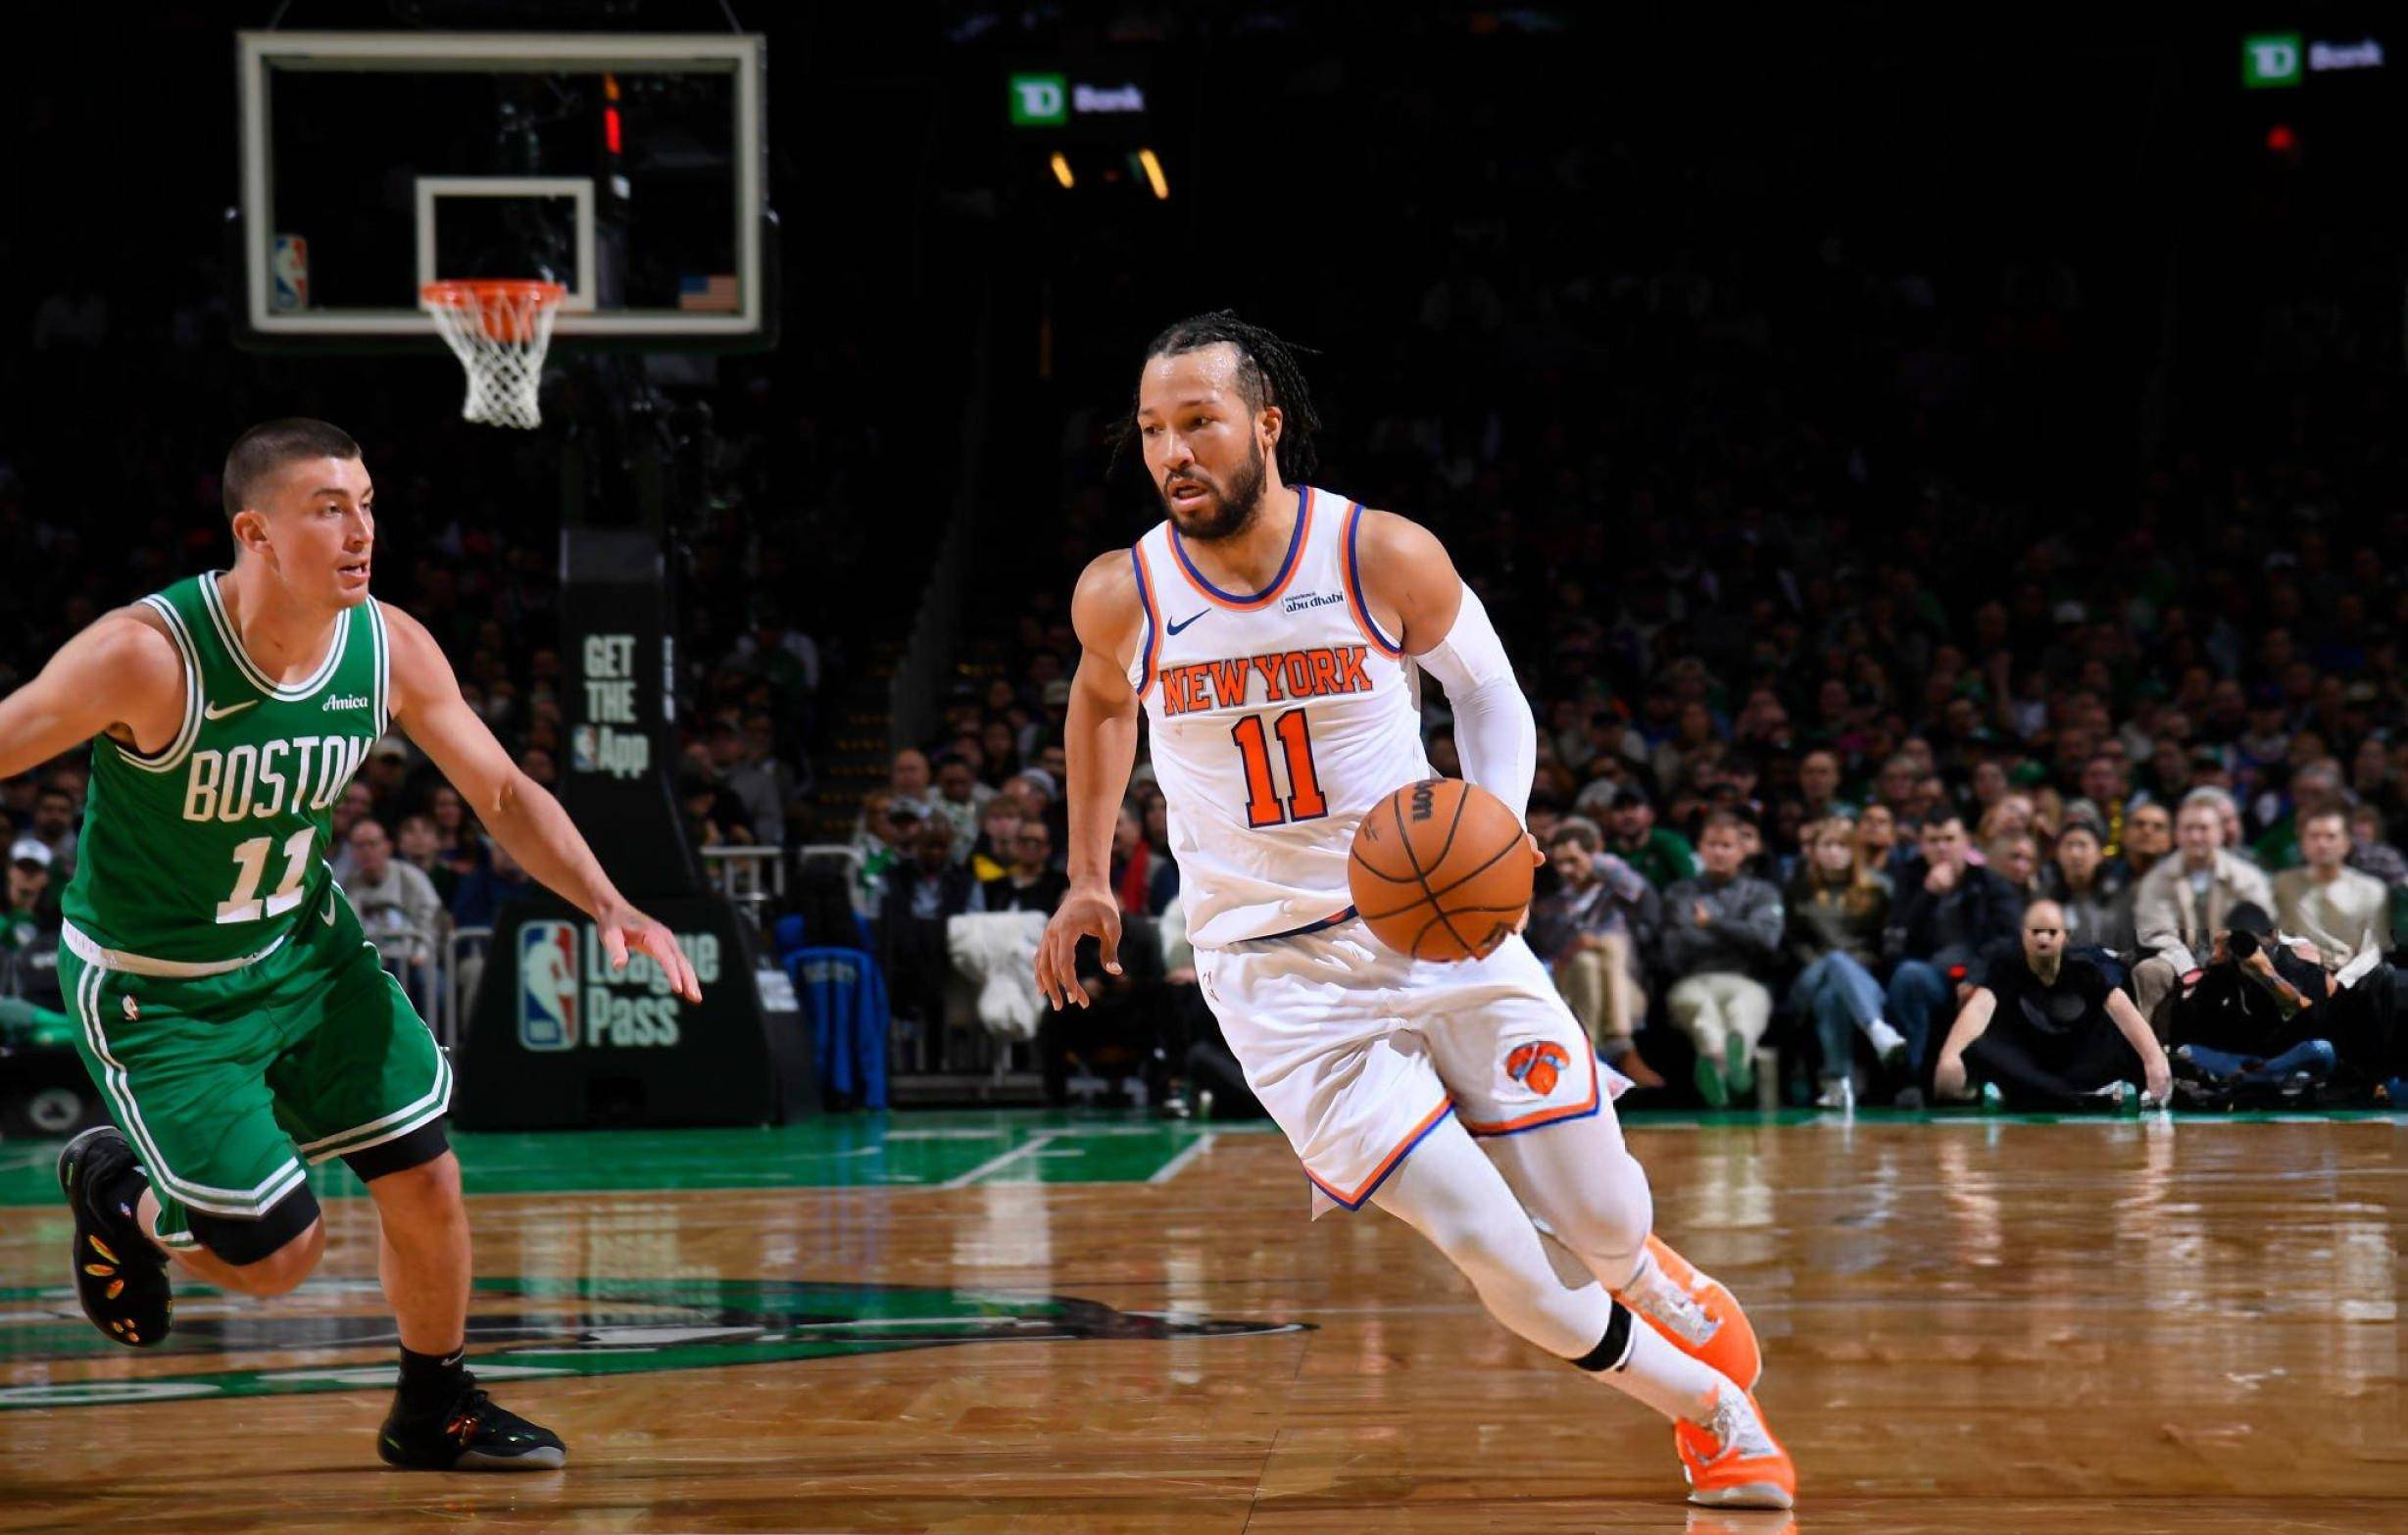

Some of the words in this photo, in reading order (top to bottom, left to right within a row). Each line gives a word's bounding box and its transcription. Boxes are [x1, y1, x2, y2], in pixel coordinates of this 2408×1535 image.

[2250, 42, 2296, 77] TD
[2309, 39, 2383, 71] Bank
[1015, 82, 1061, 117] TD
[1074, 84, 1144, 113] Bank
[1286, 600, 1308, 613] abu
[1309, 590, 1344, 608] dhabi
[584, 635, 636, 678] GET
[321, 693, 369, 712] Amica
[585, 681, 637, 723] THE
[1160, 658, 1250, 718] NEW
[1252, 645, 1373, 702] YORK
[598, 725, 649, 779] App
[1231, 708, 1329, 828] 11
[216, 826, 317, 924] 11
[586, 986, 680, 1048] Pass
